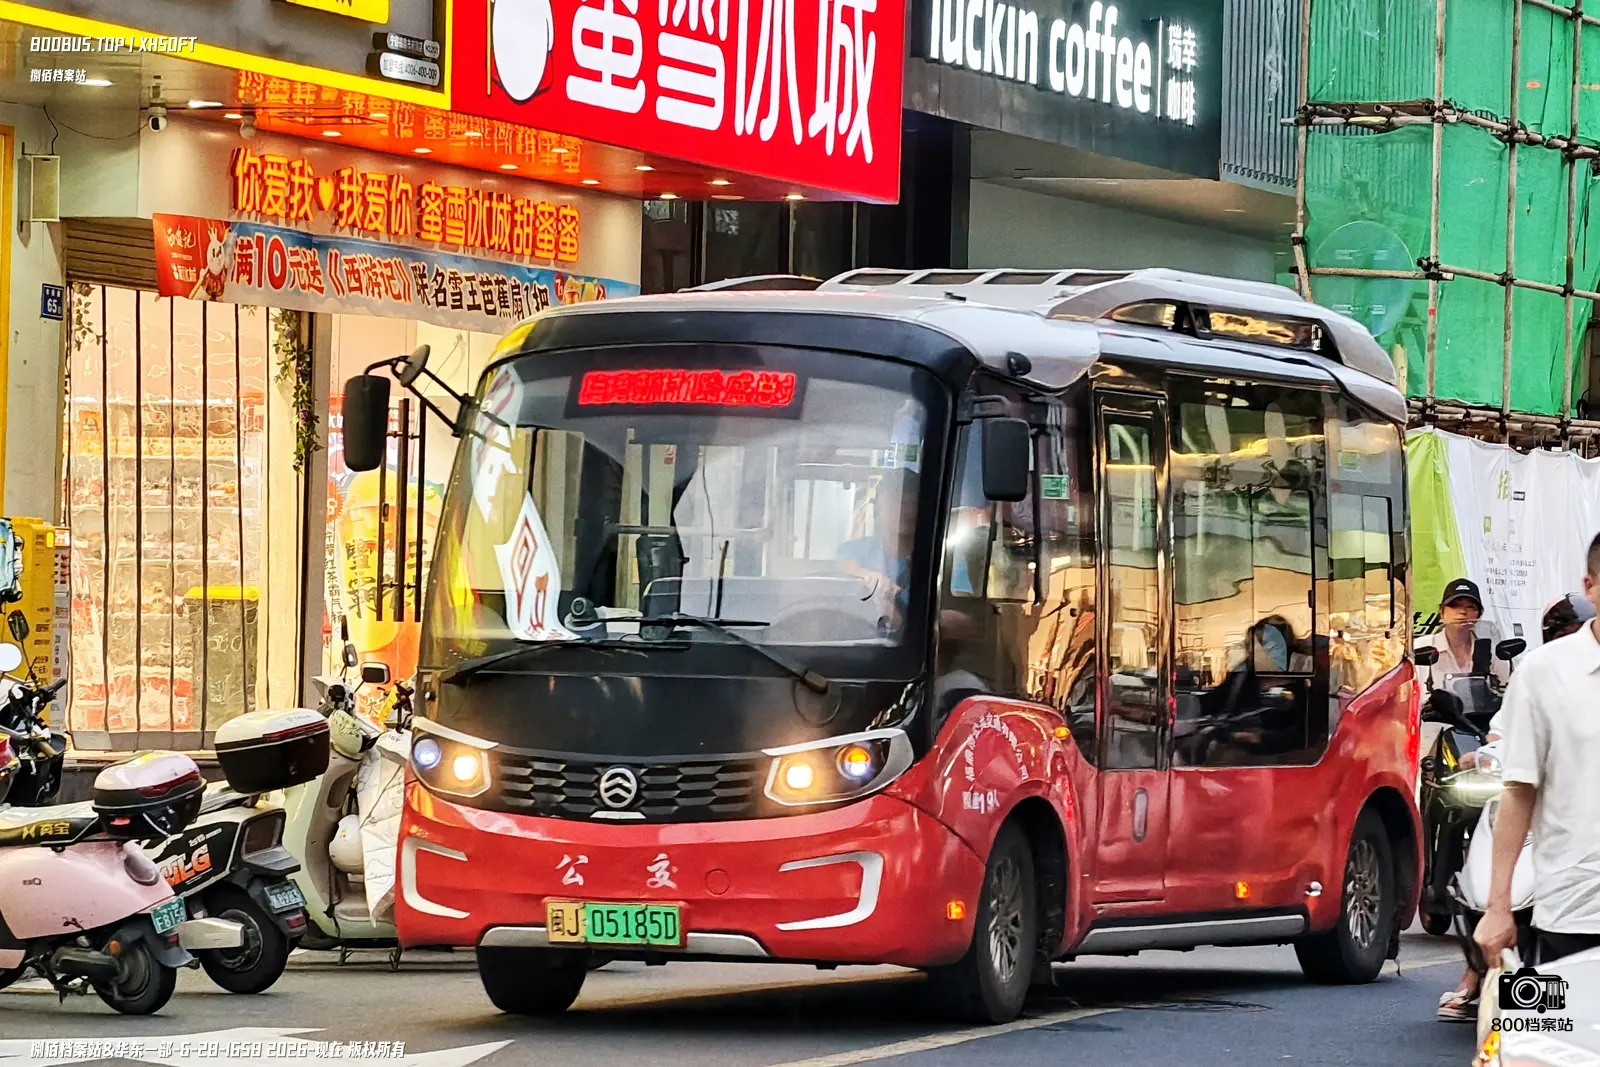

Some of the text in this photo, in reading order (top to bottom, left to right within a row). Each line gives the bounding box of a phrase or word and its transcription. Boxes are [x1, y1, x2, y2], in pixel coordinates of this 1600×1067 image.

[929, 0, 1151, 113] luckin coffee
[418, 180, 581, 263] 蜜雪冰城甜蜜蜜
